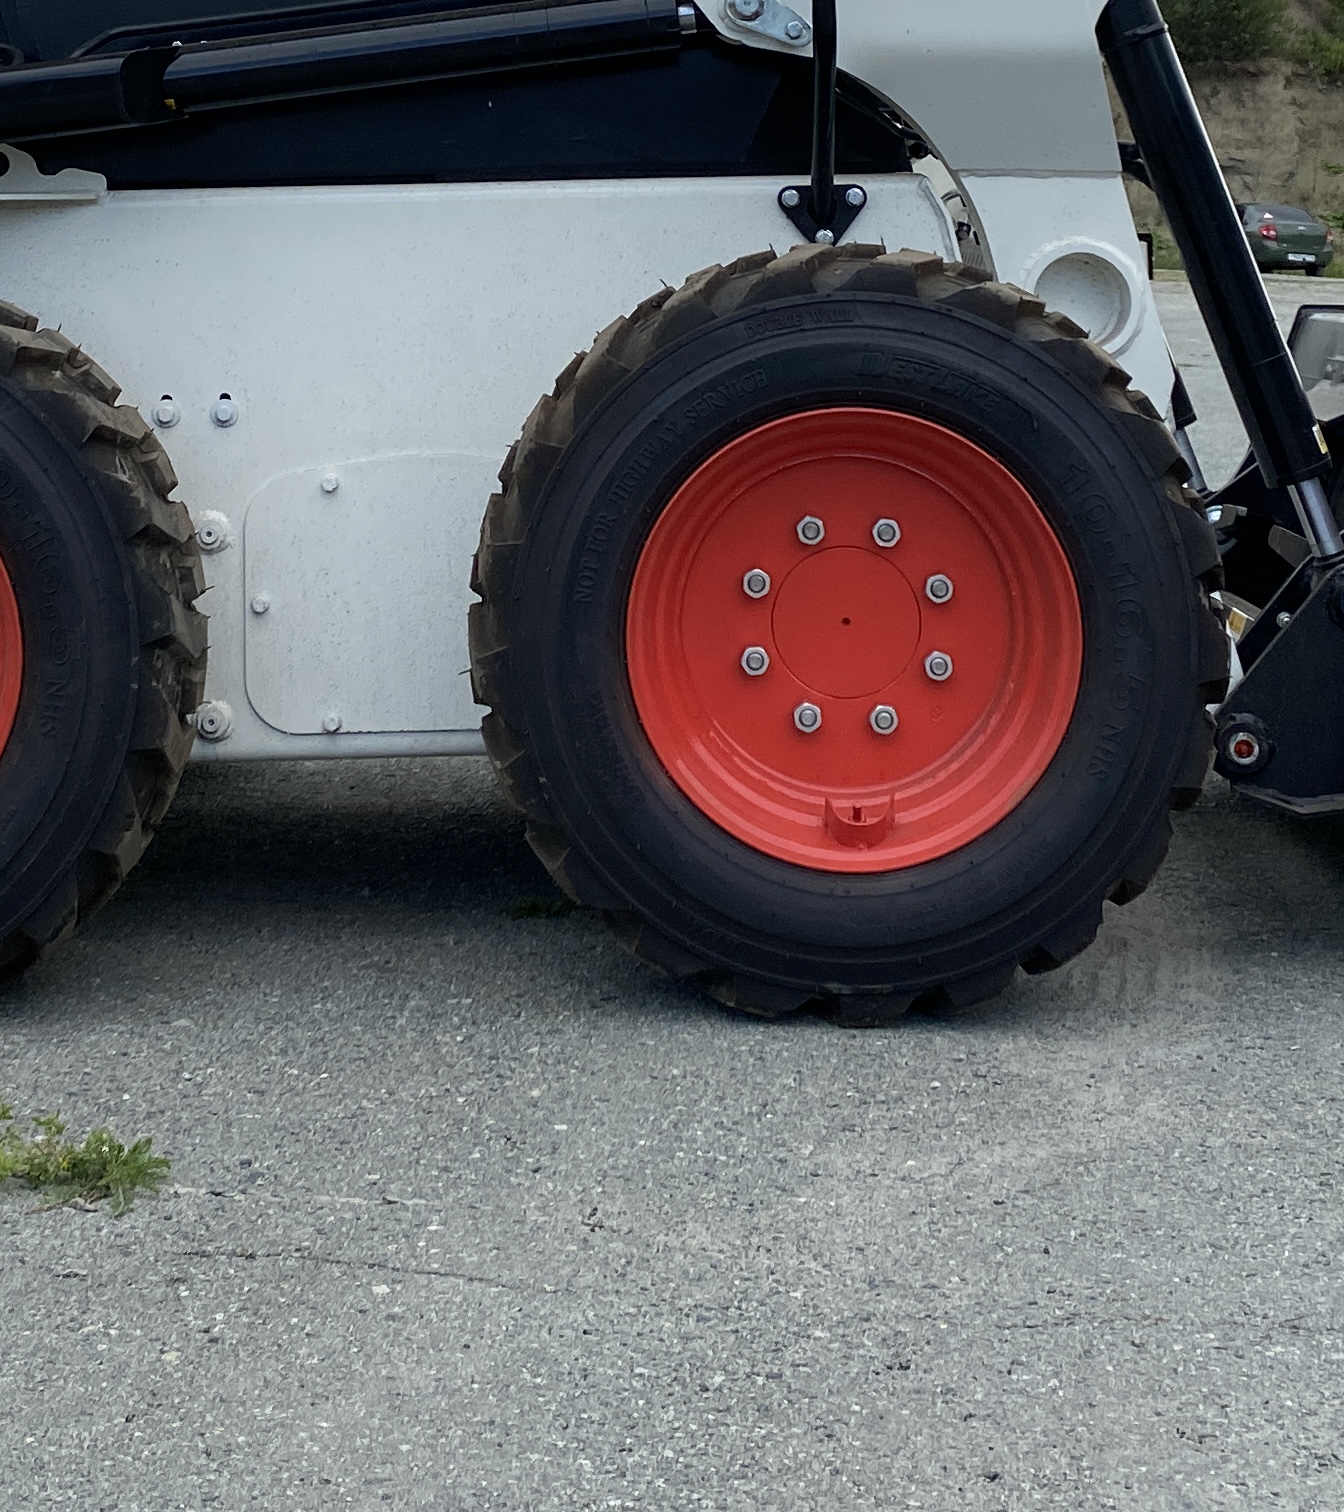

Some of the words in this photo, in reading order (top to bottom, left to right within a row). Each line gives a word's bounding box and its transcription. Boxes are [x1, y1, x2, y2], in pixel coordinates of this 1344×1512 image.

[683, 368, 770, 426] SERVICE
[606, 418, 683, 506] HIGHWAY
[584, 511, 618, 553] FOR
[573, 558, 600, 604] NOT
